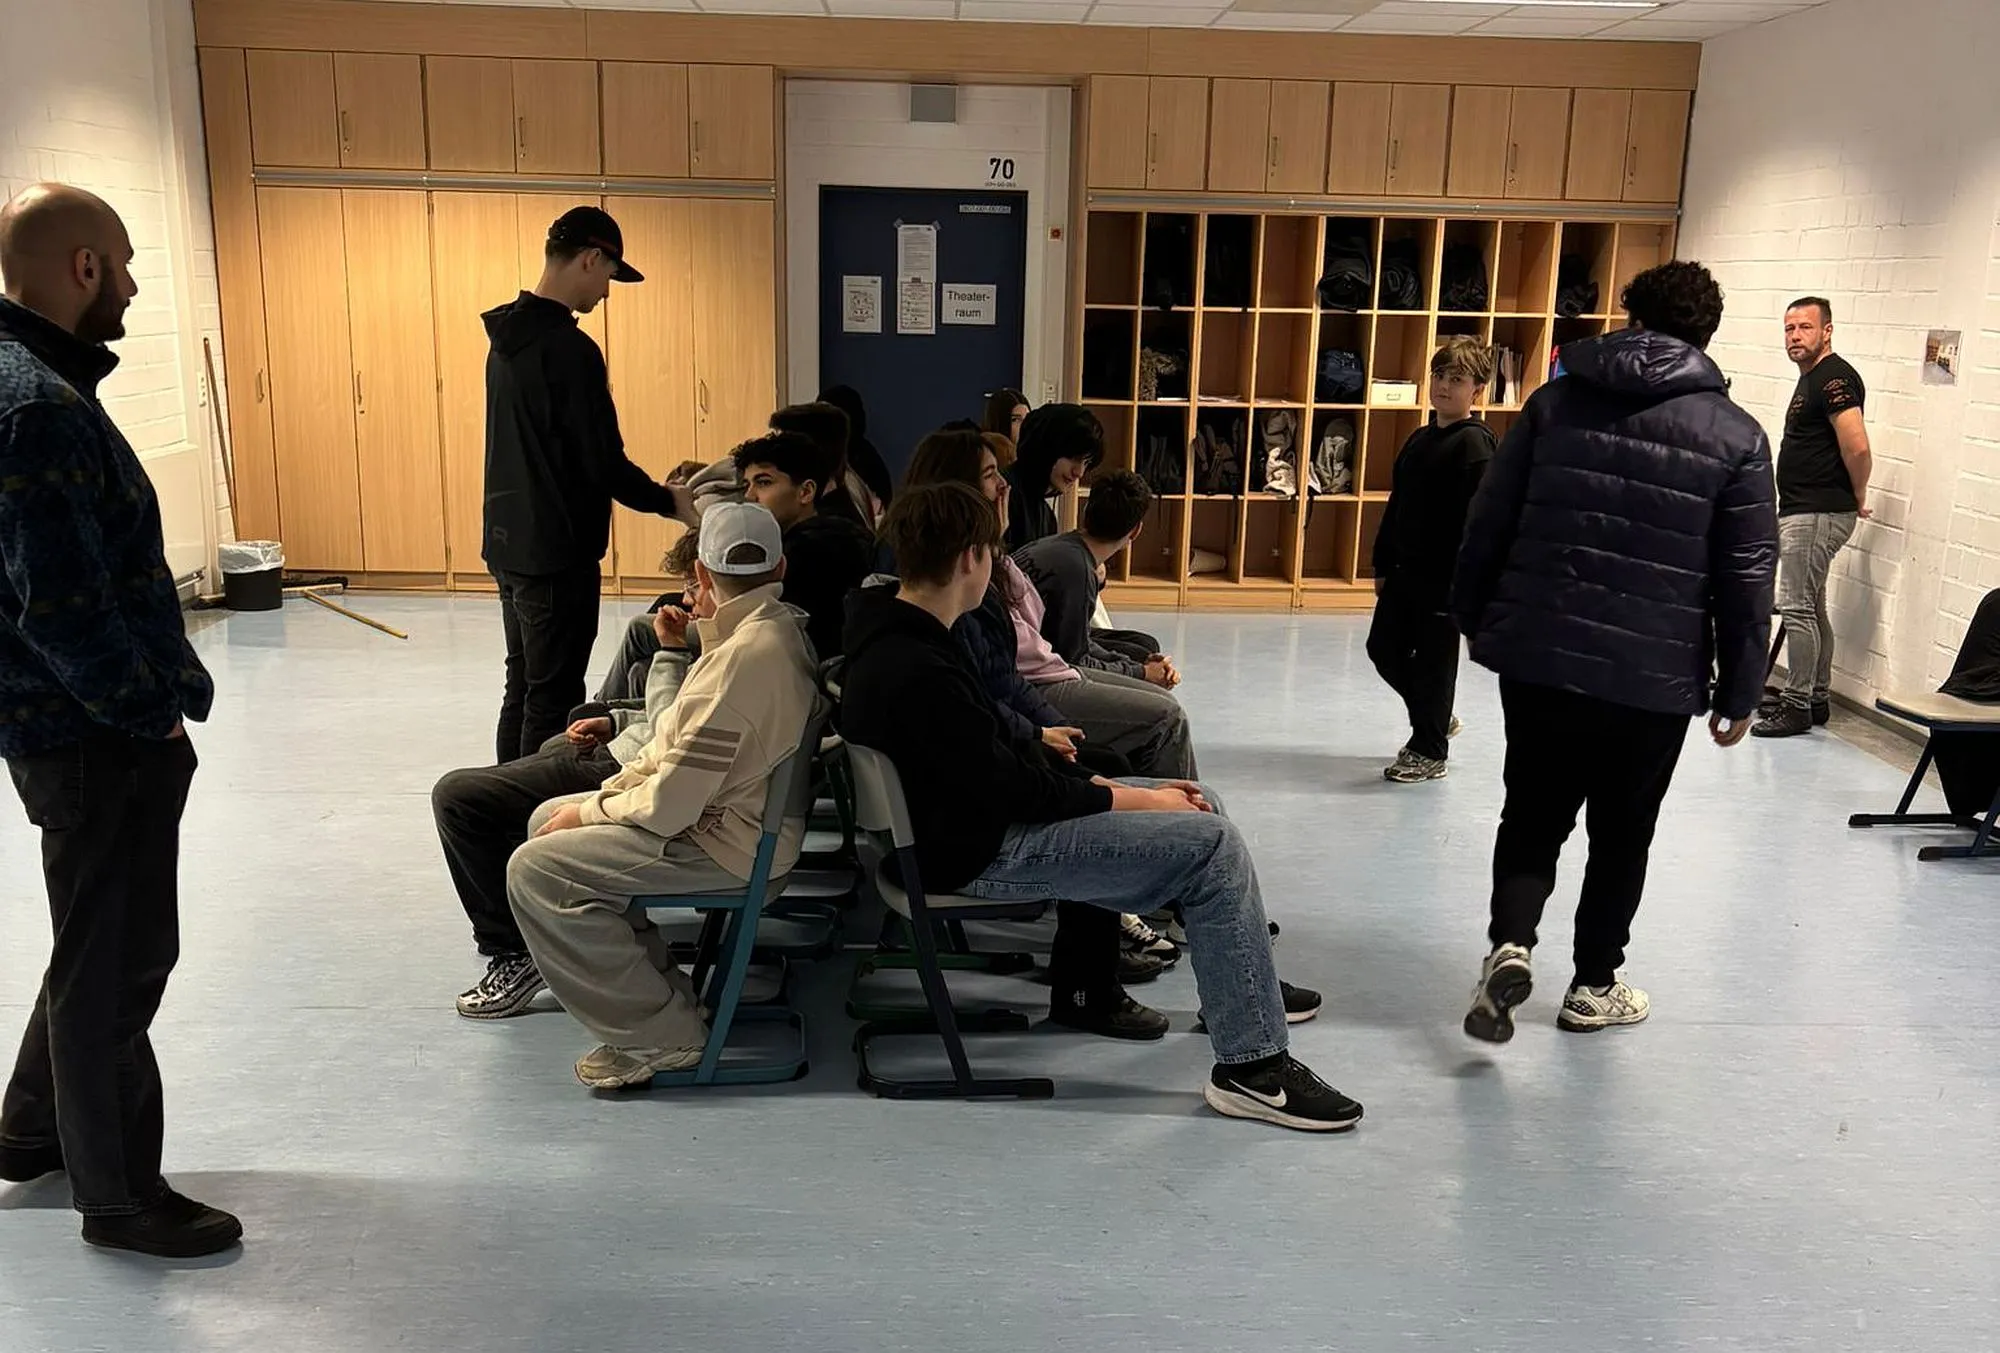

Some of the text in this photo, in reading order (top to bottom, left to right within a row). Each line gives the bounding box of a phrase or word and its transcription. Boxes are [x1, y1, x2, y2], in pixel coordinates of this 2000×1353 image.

[990, 158, 1014, 179] 70
[947, 290, 991, 302] Theater-
[955, 309, 981, 318] raum
